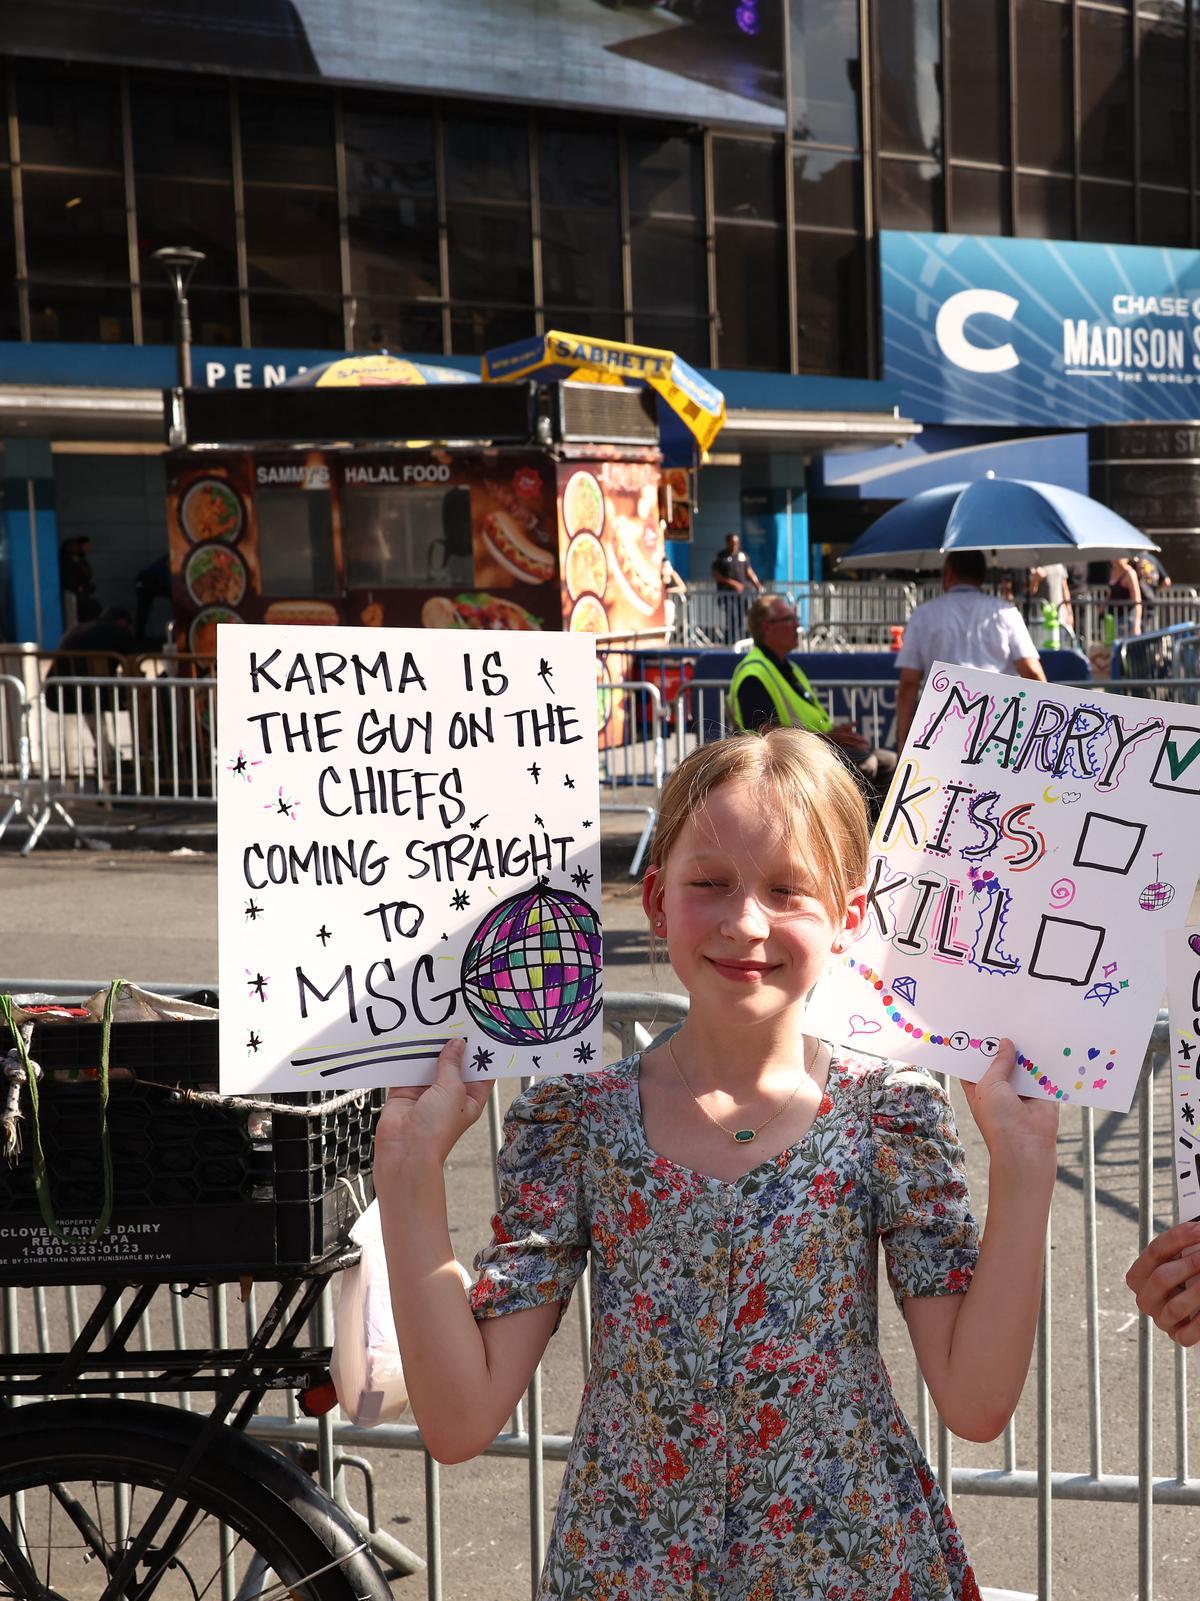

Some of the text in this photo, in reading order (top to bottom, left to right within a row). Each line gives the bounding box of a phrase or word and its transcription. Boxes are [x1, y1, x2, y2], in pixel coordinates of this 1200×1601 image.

[1112, 294, 1189, 318] CHASE
[556, 339, 665, 374] SABRETT
[1063, 318, 1185, 369] MADISON
[206, 362, 309, 389] PEN
[1116, 371, 1143, 383] THE
[257, 465, 450, 484] SAMMY'S HALAL FOOD
[249, 648, 509, 696] KARMA IS
[246, 702, 583, 754] THE GUY ON THE
[913, 684, 1164, 789] MARRY
[318, 765, 466, 829] CHIEFS
[880, 762, 1044, 868] KISS
[242, 832, 575, 890] COMING STRAIGHT
[364, 900, 425, 943] TO
[866, 859, 1021, 971] KILL
[295, 954, 464, 1037] MSG
[22, 1243, 140, 1256] 1-800-323-0123
[110, 1234, 130, 1244] PA
[117, 1223, 162, 1235] DAIRY
[24, 1256, 48, 1264] OTHER
[70, 1255, 96, 1263] OWNER
